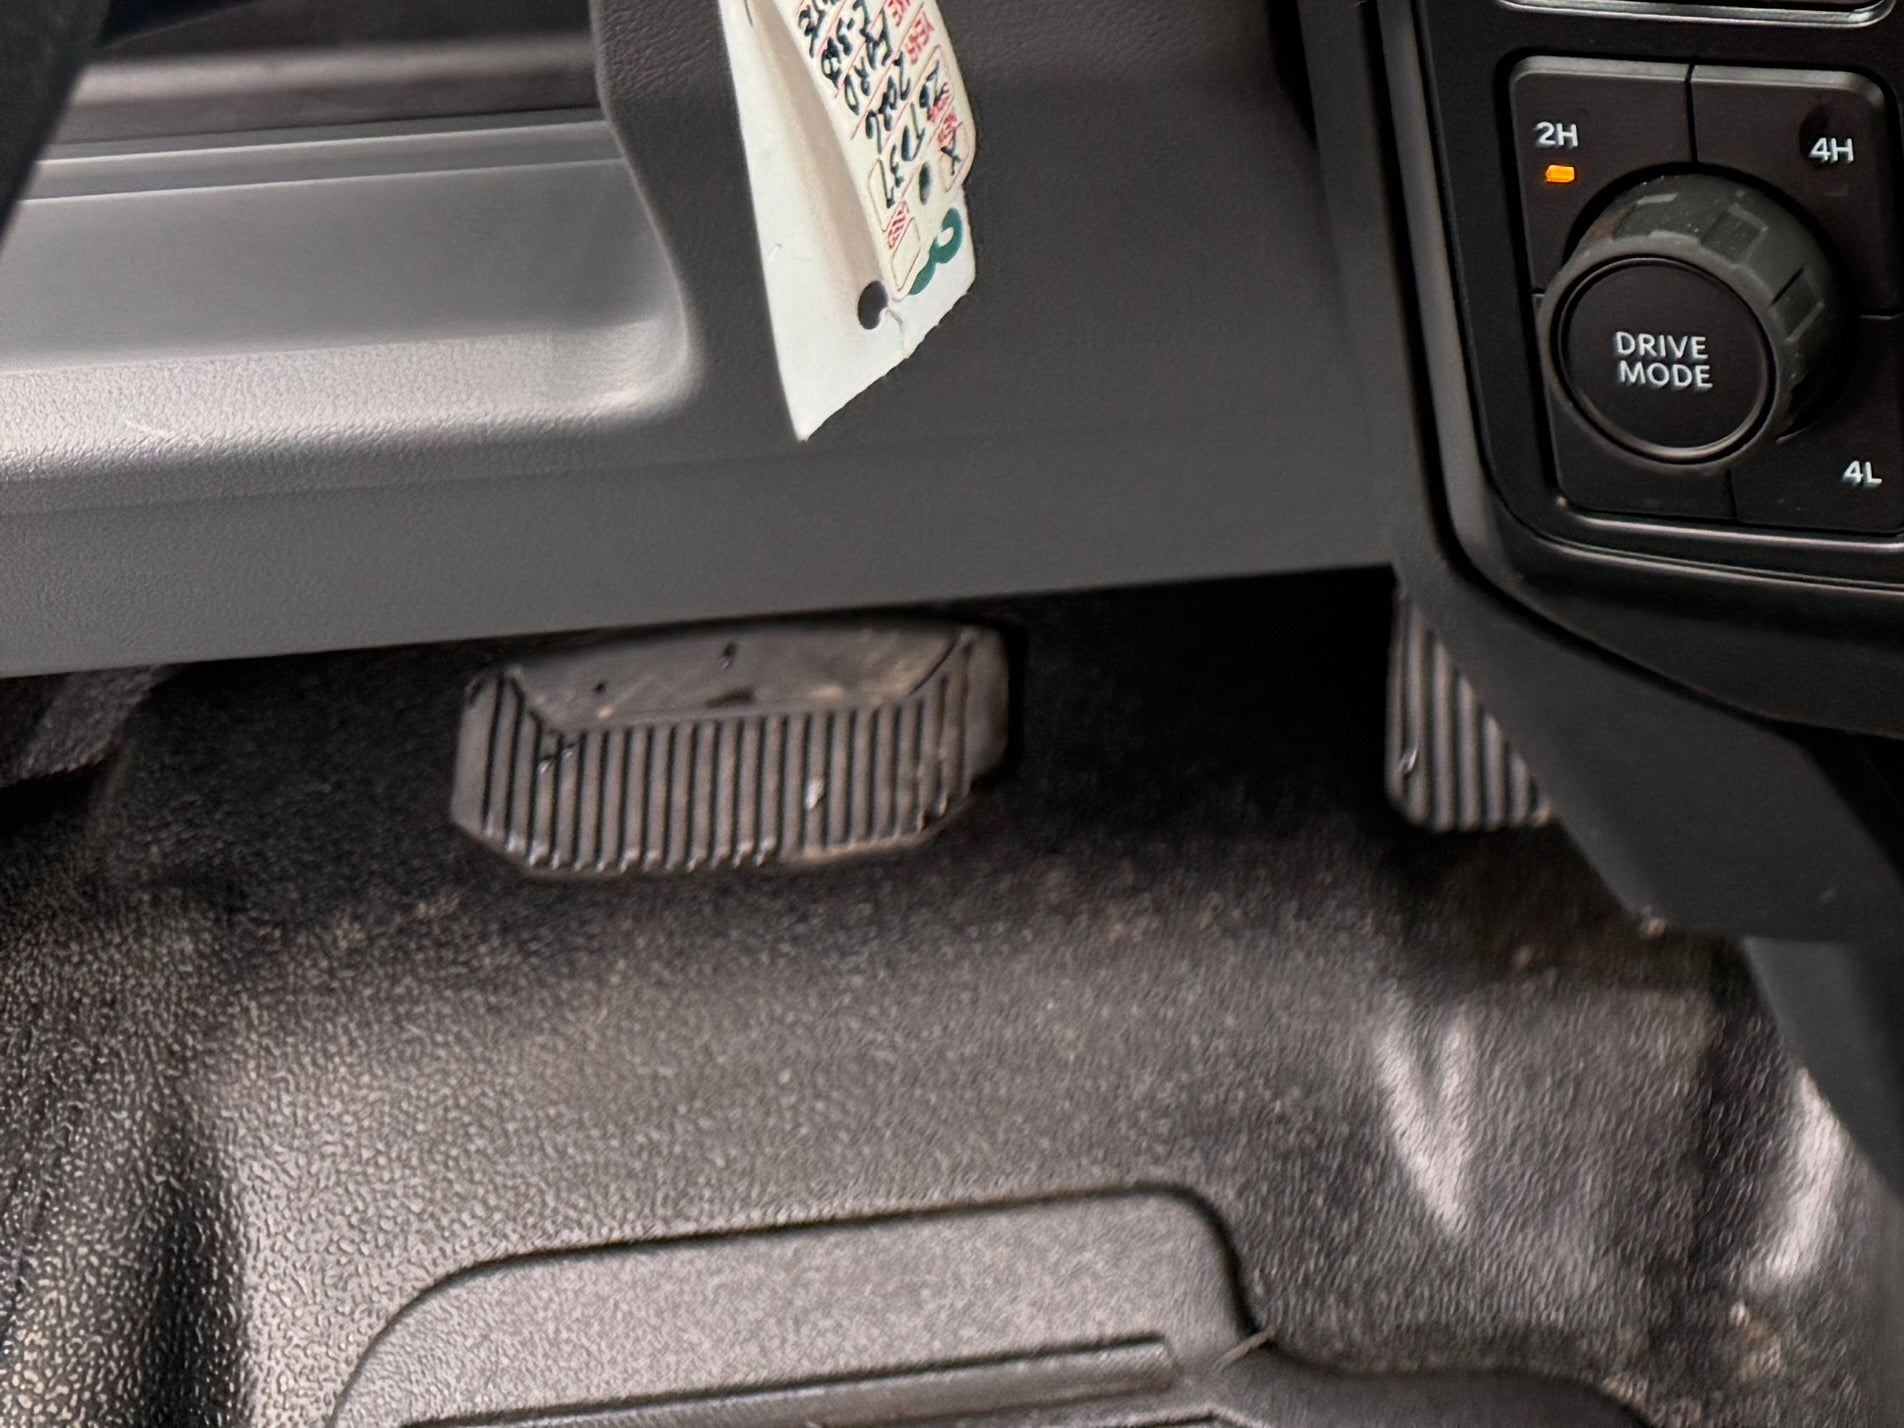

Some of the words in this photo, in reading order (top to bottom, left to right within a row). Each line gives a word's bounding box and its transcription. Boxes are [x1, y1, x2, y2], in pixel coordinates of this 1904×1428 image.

[1536, 122, 1578, 148] 2H
[1809, 137, 1854, 162] 4H
[1614, 331, 1708, 361] DRIVE
[1617, 359, 1713, 392] MODE
[1843, 460, 1883, 485] 4L
